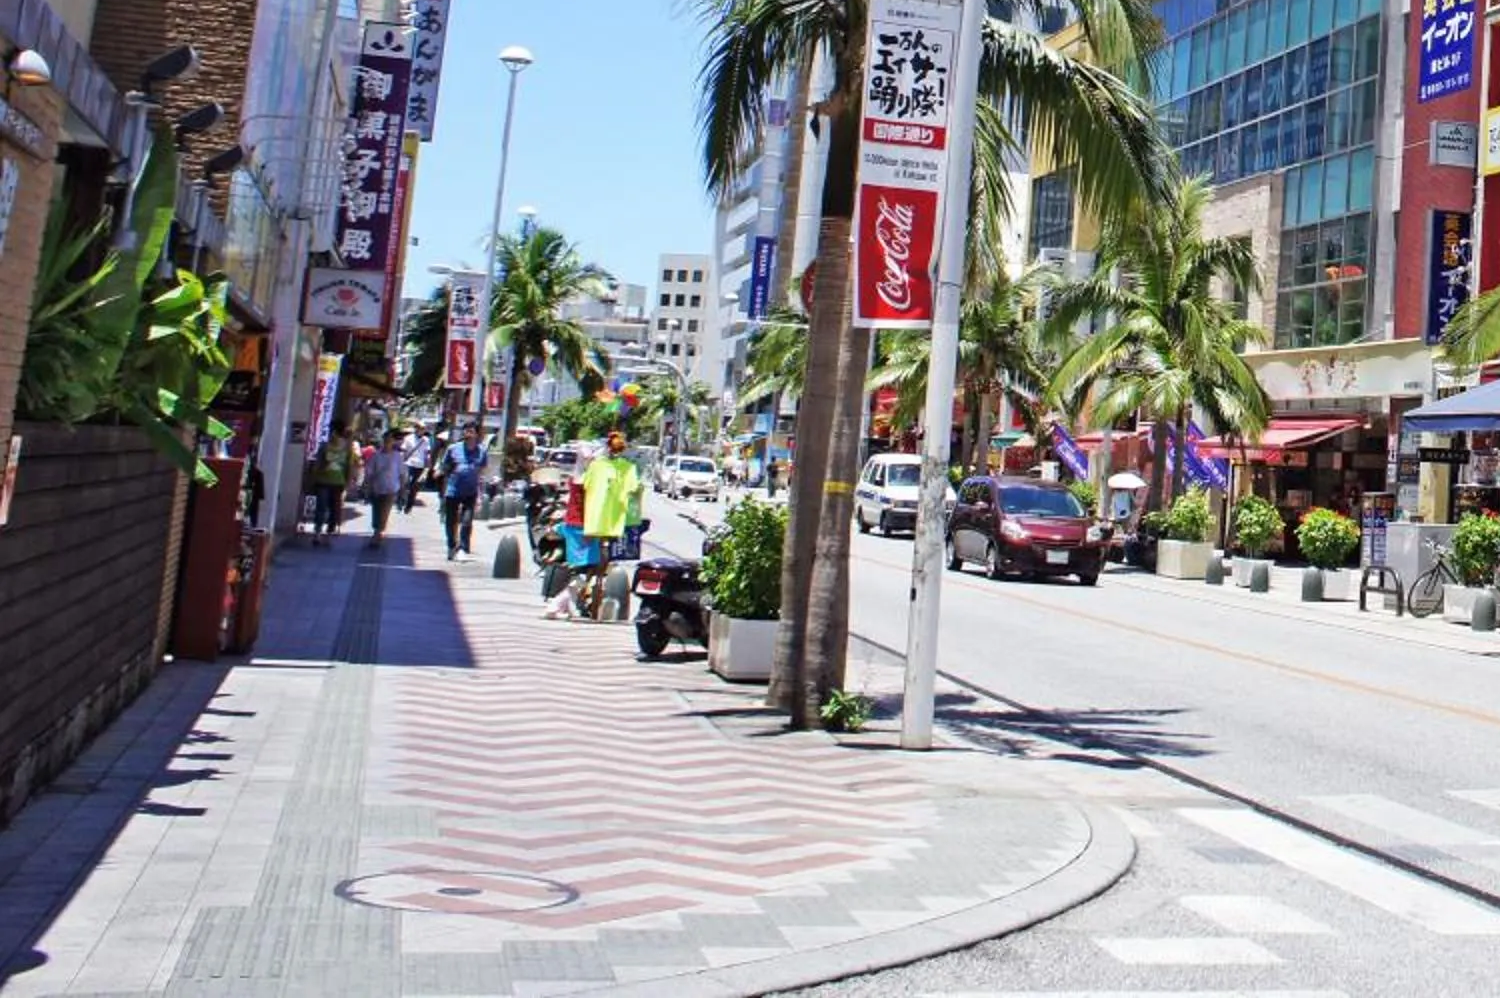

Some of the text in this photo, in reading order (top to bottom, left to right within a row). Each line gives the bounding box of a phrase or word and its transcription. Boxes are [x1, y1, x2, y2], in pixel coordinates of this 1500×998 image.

[879, 30, 943, 53] 一万人の
[1422, 12, 1474, 52] イーオン
[875, 195, 915, 310] Coca-Cola
